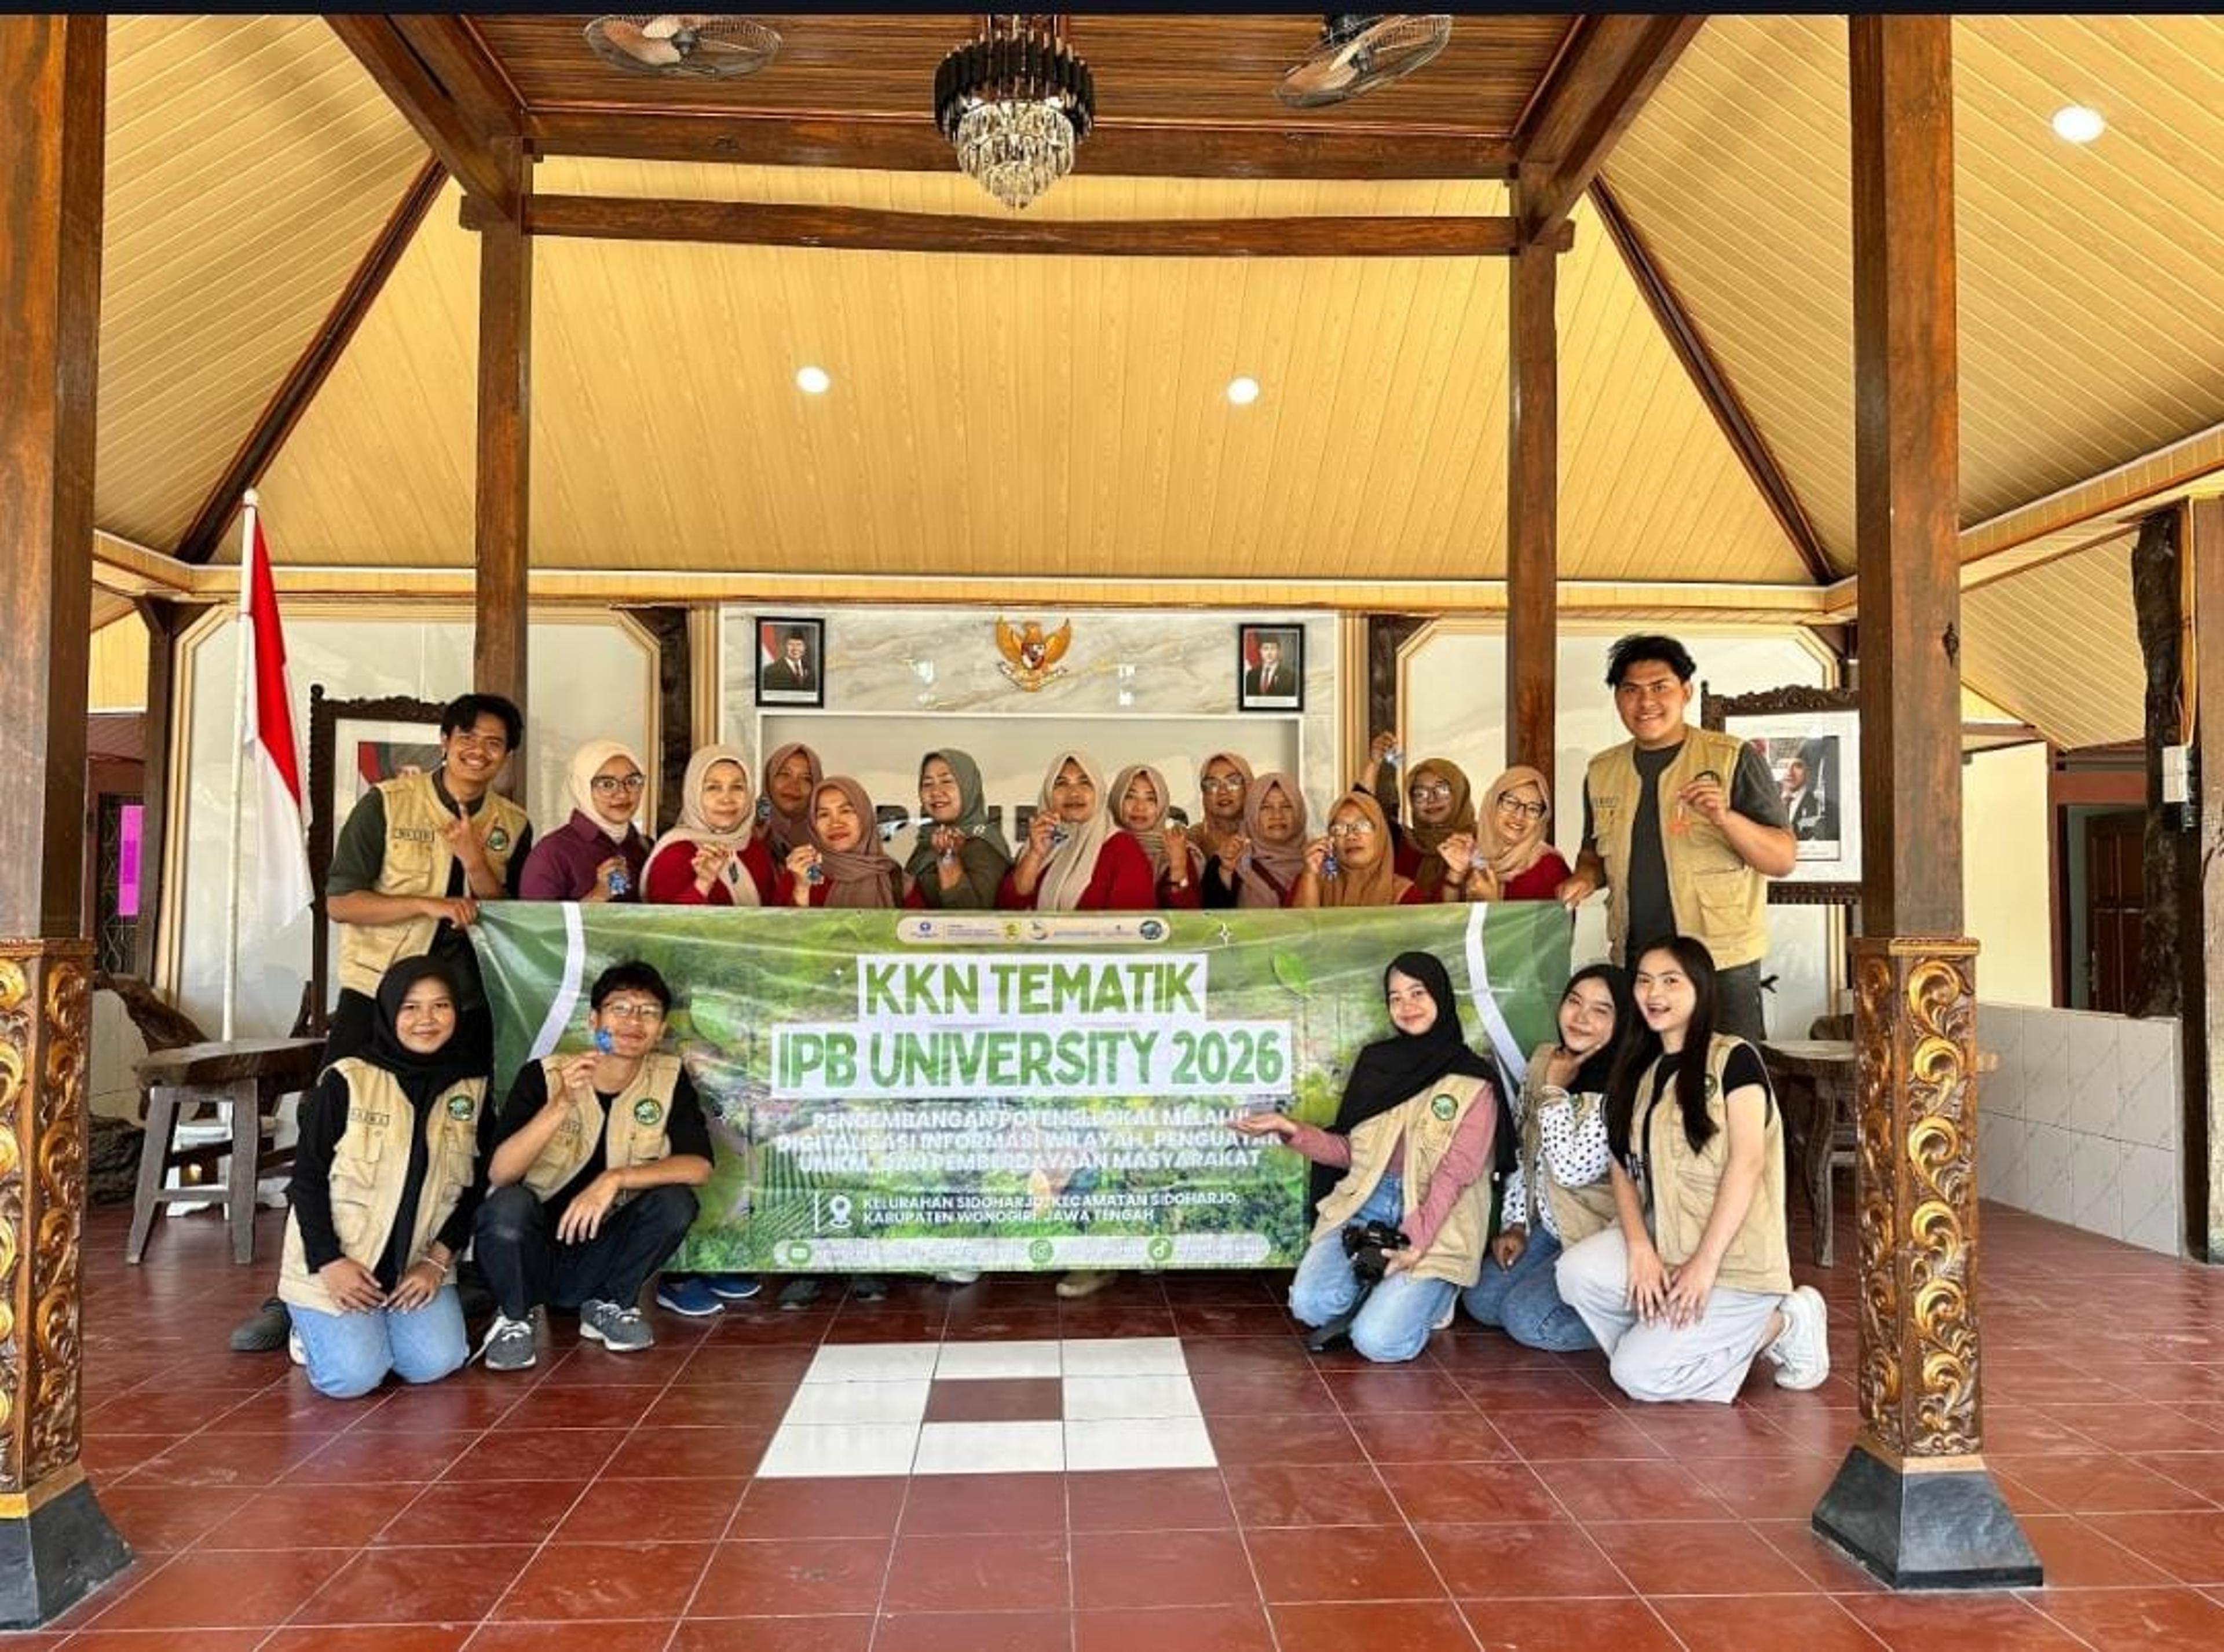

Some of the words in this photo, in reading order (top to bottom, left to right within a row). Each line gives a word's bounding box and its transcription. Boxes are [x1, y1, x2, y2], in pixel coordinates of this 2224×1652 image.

[866, 963, 979, 1015] KKN
[990, 962, 1200, 1014] TEMATIK
[778, 1032, 857, 1088] IPB
[870, 1030, 1158, 1088] UNIVERSITY
[1170, 1029, 1284, 1085] 2026
[812, 1109, 994, 1128] PENGEMBANGAN
[999, 1108, 1086, 1127] POTENSI
[1092, 1108, 1158, 1126] LOKAL
[776, 1134, 916, 1152] DIGITALISASI
[920, 1132, 1040, 1149] INFORMASI
[932, 1150, 1109, 1170] PEMBERDAYAAN
[1113, 1148, 1261, 1168] MASYARAKAT
[864, 1196, 953, 1210] KELURAHAN
[1052, 1193, 1147, 1207] KECAMATAN
[863, 1211, 952, 1225] KABUPATEN
[1093, 1208, 1154, 1221] TENGAH
